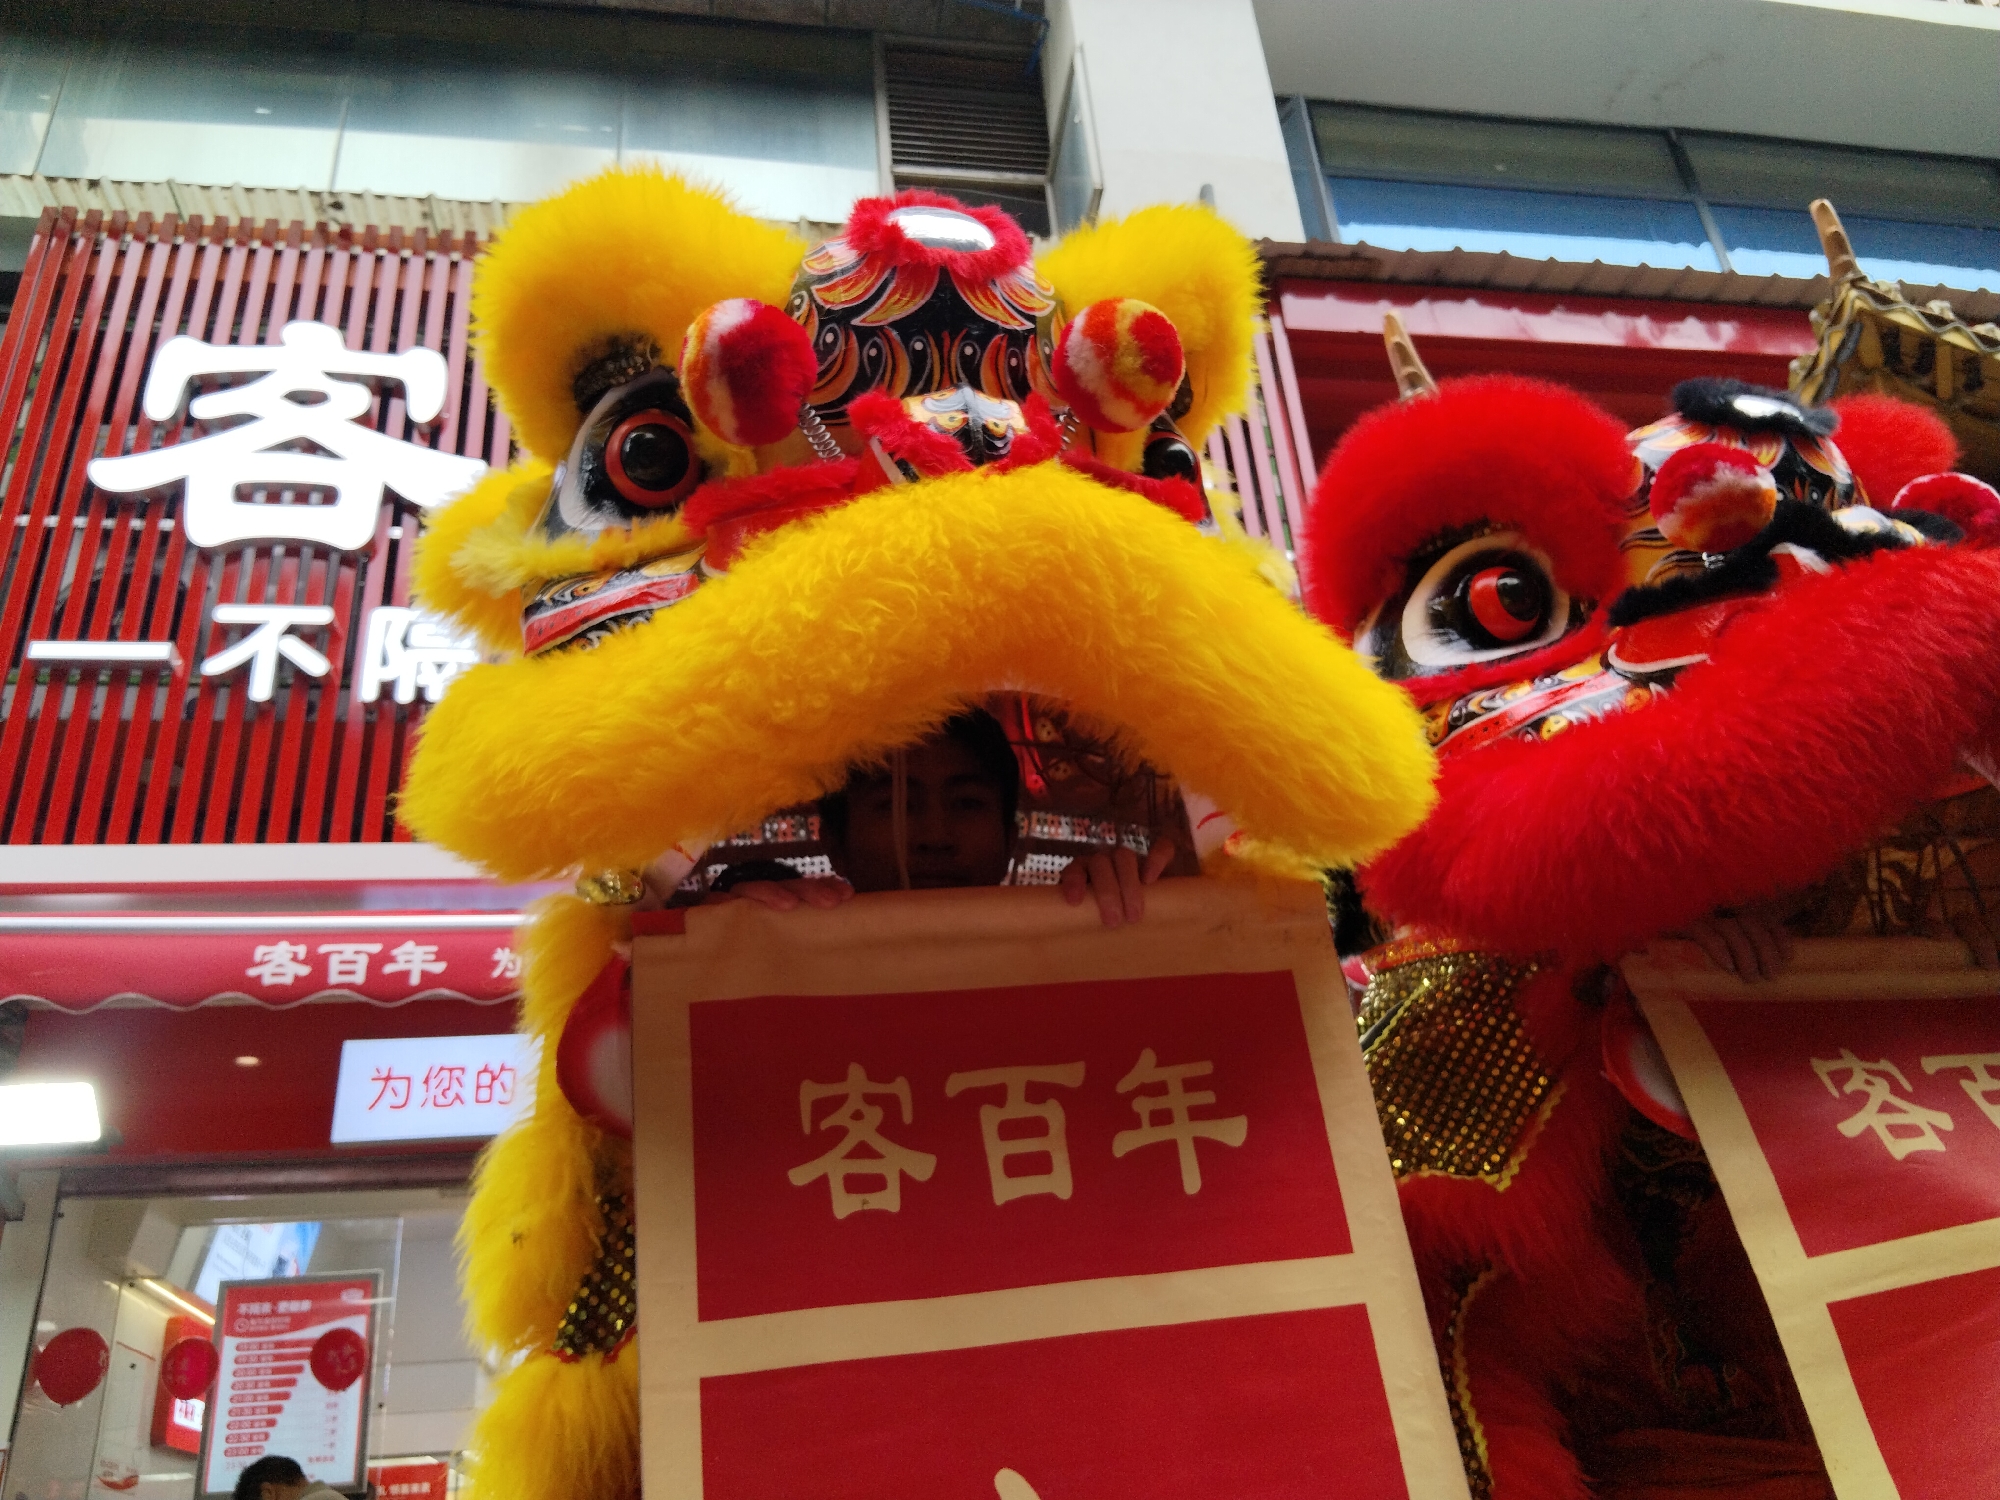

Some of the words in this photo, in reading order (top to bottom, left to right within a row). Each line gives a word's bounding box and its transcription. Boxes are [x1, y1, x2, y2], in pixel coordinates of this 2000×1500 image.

[87, 320, 488, 550] 客
[246, 940, 447, 986] 客百年
[368, 1062, 518, 1111] 为您的
[788, 1047, 1248, 1219] 客百年
